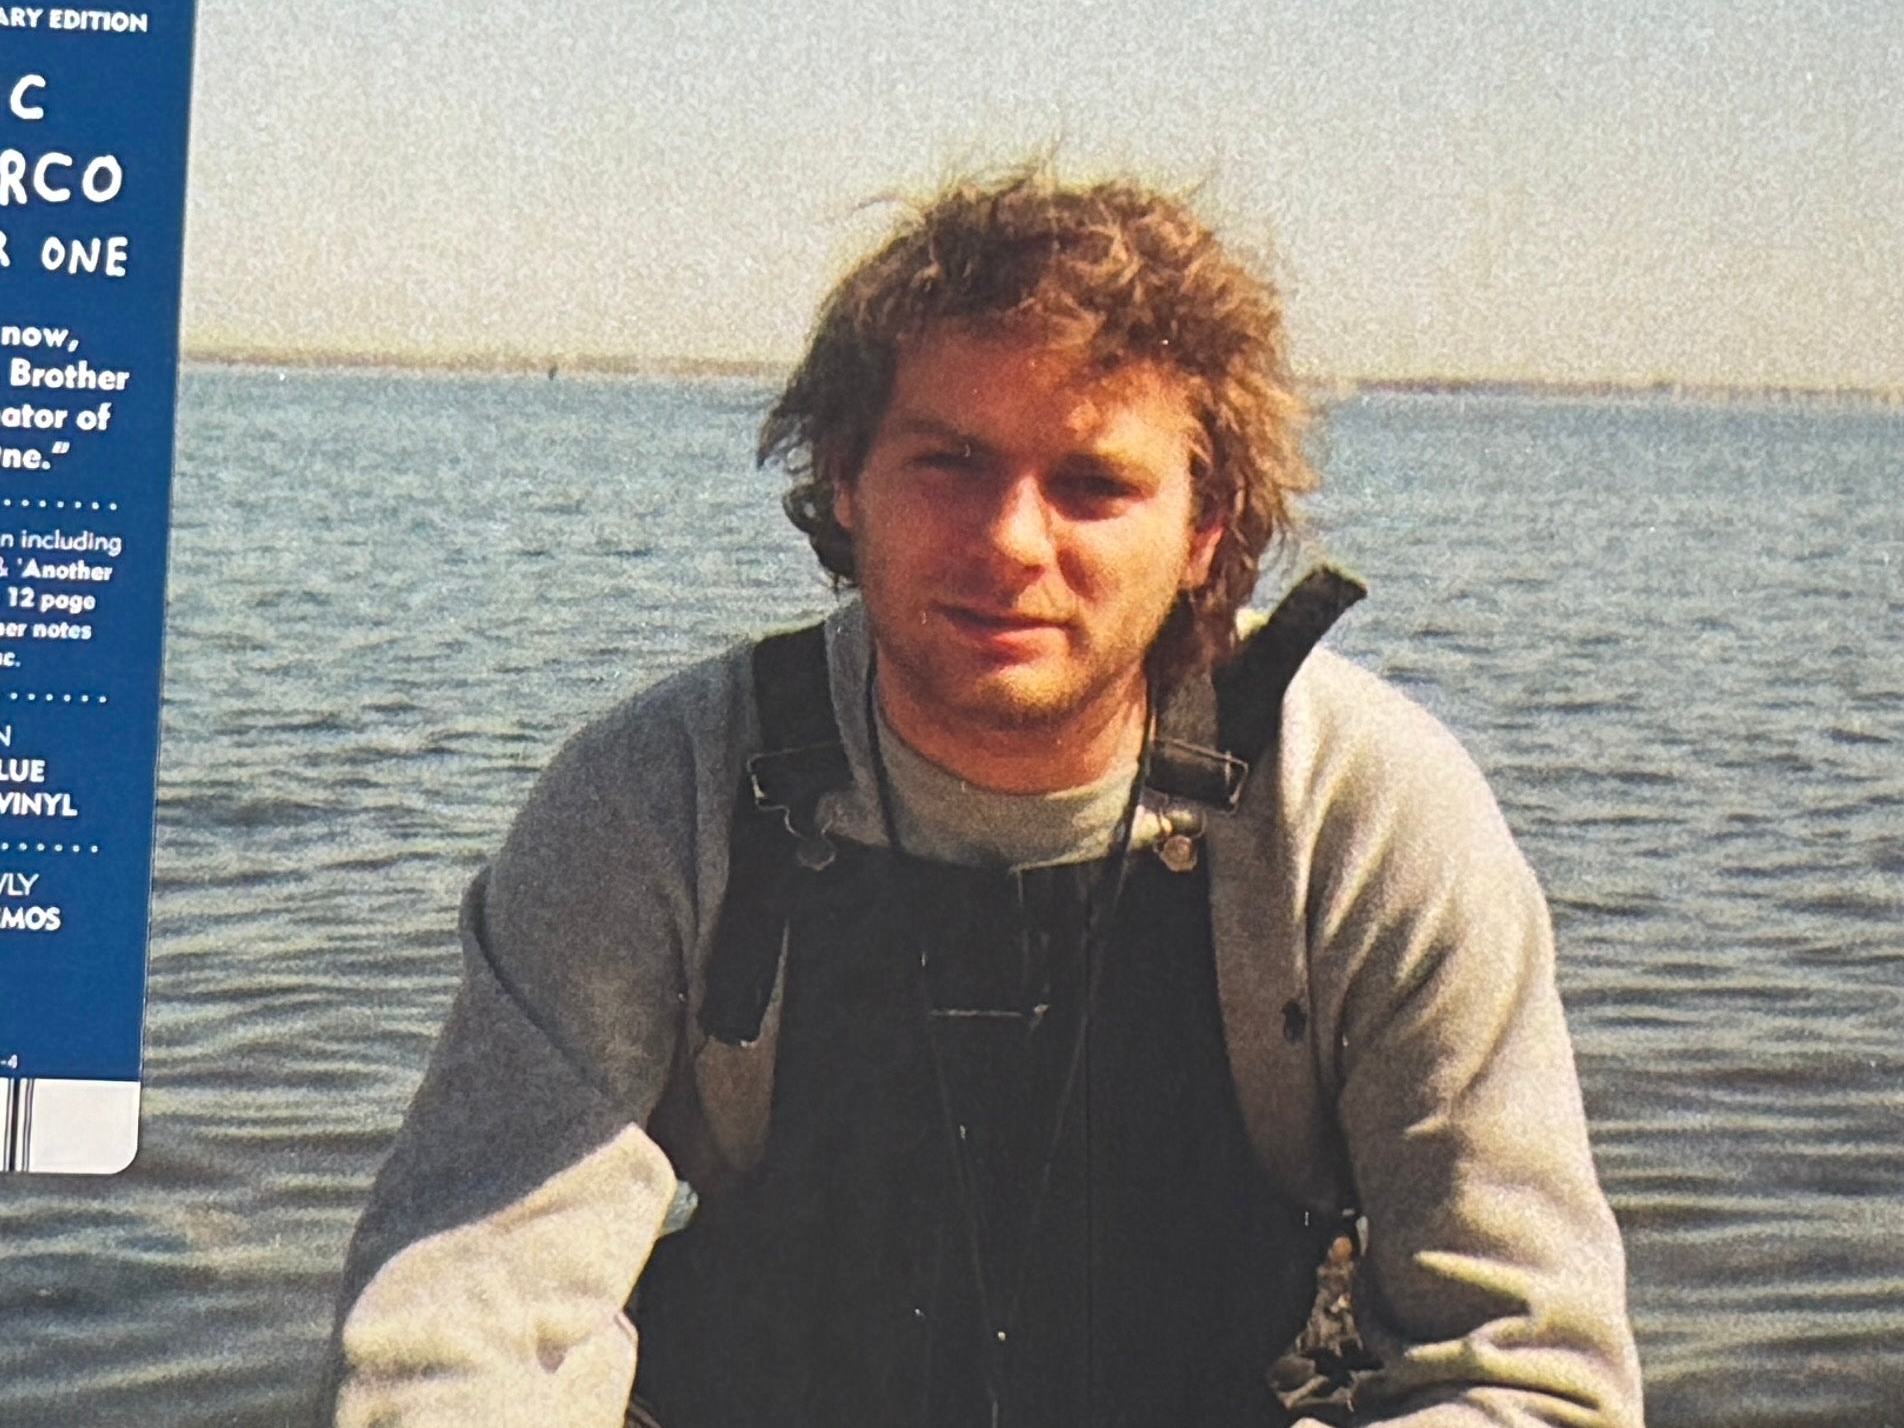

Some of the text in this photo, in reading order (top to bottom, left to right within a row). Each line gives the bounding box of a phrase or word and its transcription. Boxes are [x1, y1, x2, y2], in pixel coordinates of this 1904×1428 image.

[49, 9, 147, 32] EDITION
[41, 236, 128, 277] ONE
[1, 326, 78, 352] now,
[10, 357, 129, 390] Brother
[76, 402, 111, 430] of
[21, 530, 121, 557] including
[8, 587, 34, 608] 12
[40, 594, 95, 614] page
[33, 622, 91, 639] notes
